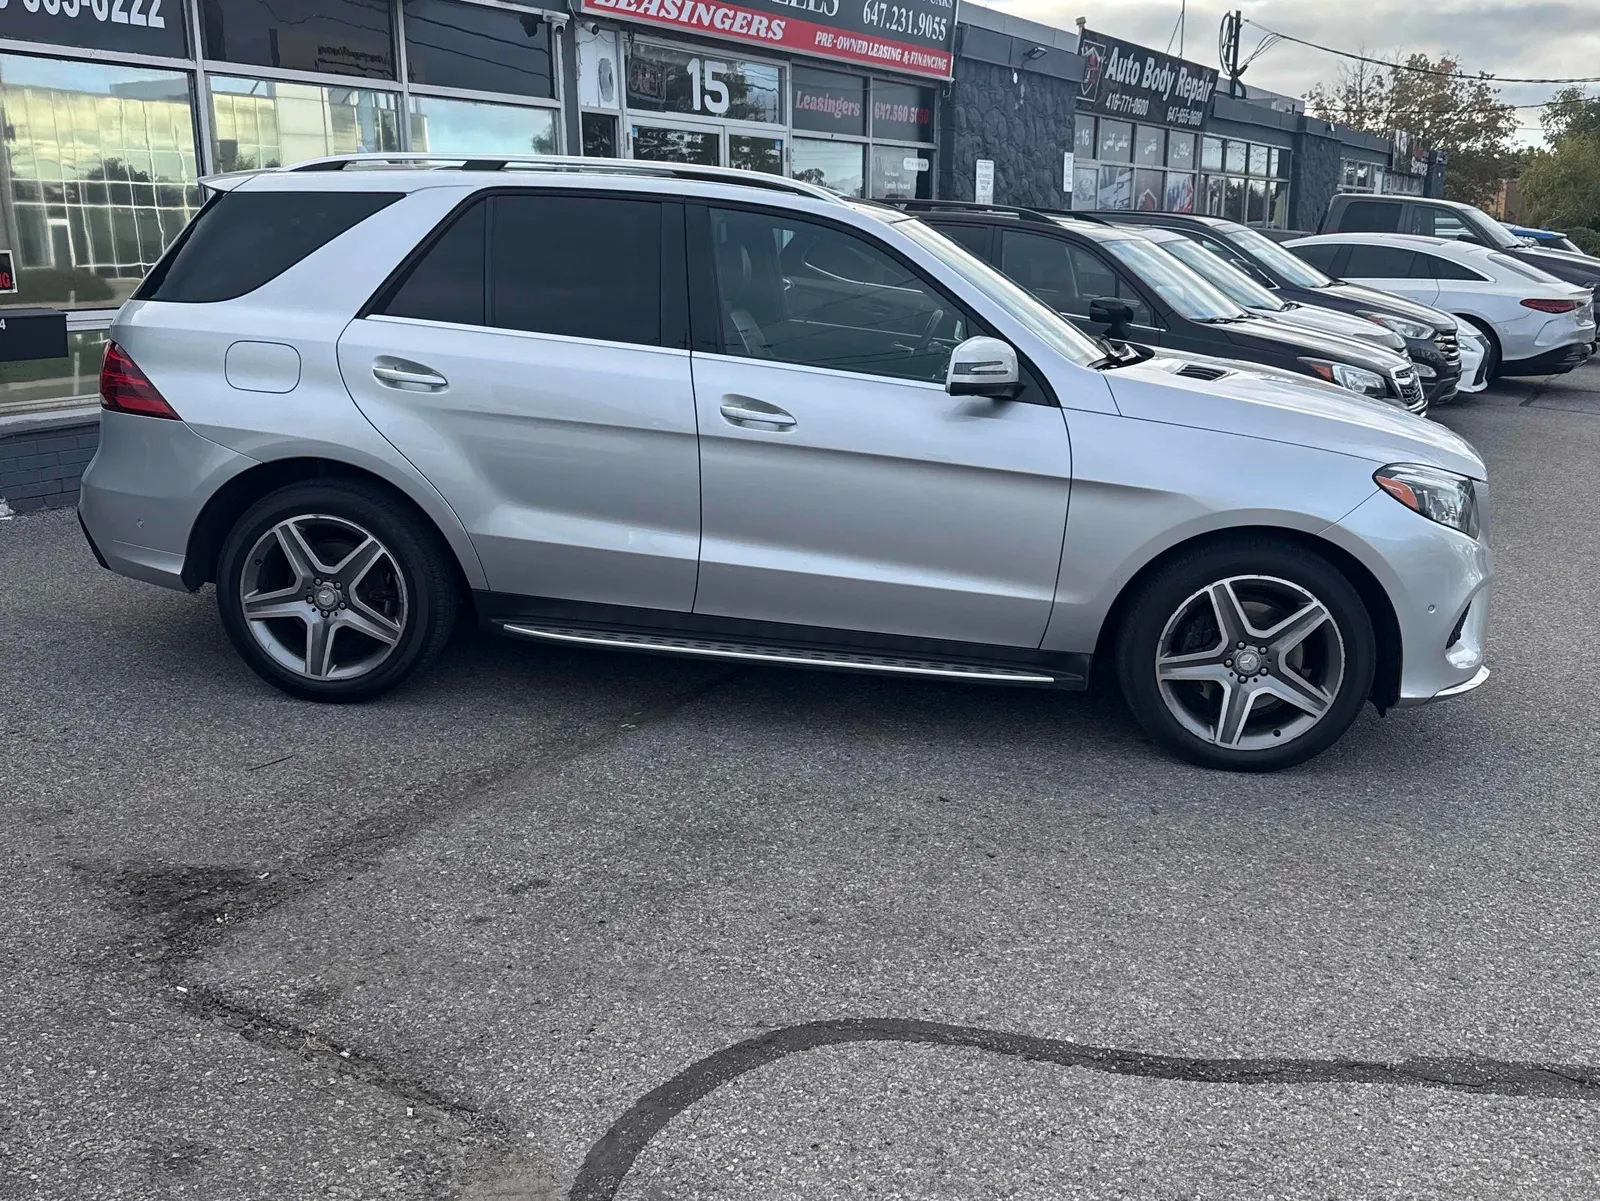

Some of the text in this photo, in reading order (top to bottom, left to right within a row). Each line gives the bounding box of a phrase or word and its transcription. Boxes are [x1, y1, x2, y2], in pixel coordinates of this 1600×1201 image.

[593, 0, 786, 41] ASINGERS
[863, 0, 948, 41] 647.231.9055
[868, 43, 902, 62] LEASING
[903, 51, 909, 65] &
[909, 52, 948, 71] FINANCING
[1104, 46, 1214, 106] Auto Body Repair
[686, 58, 730, 114] 15
[795, 90, 861, 118] Leasingers
[0, 272, 11, 288] G
